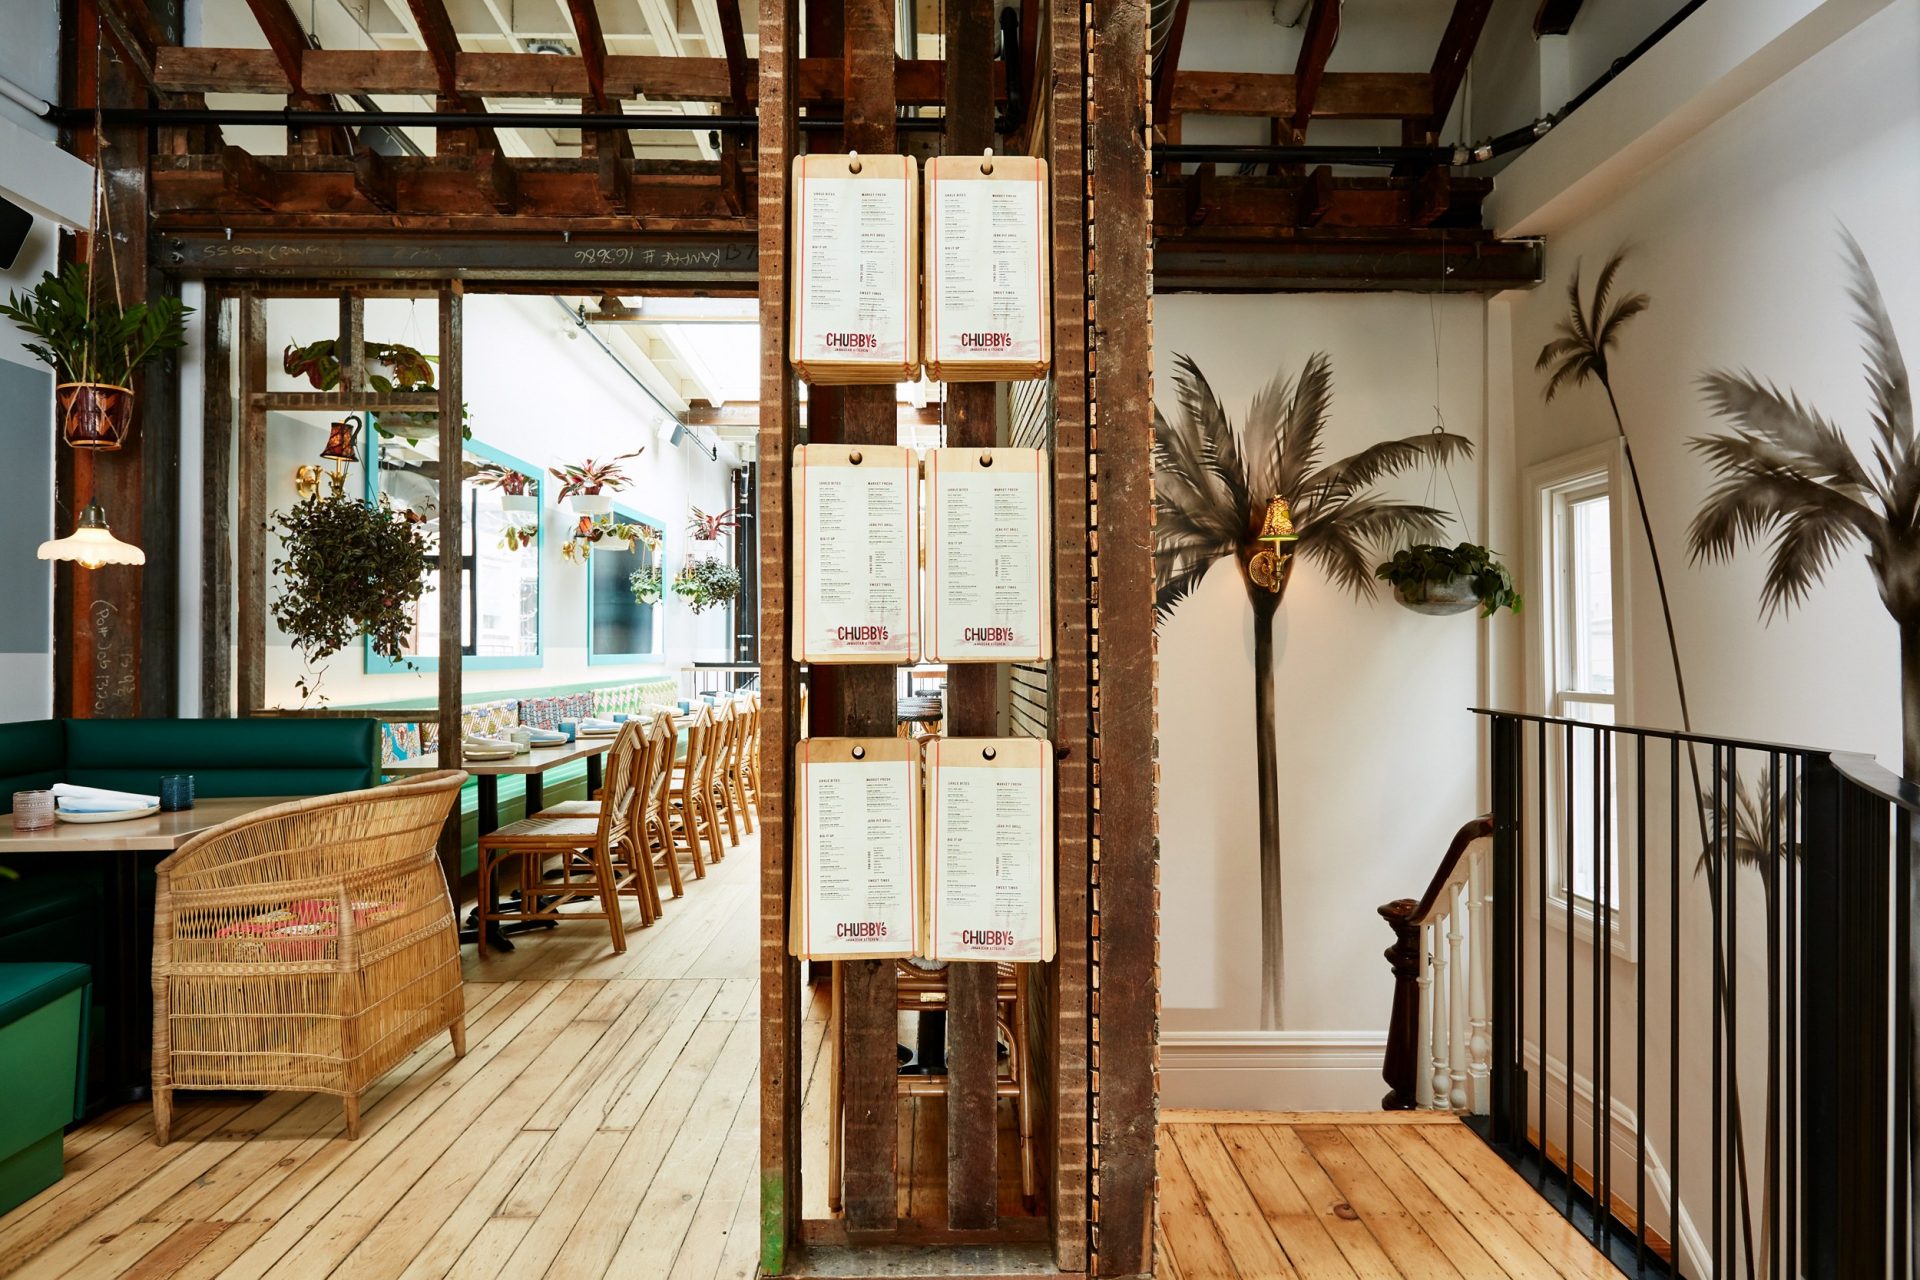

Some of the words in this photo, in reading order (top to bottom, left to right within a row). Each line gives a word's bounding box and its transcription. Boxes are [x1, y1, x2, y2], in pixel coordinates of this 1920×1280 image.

[826, 332, 877, 348] CHUBBY's
[961, 333, 1012, 347] CHUBBY's
[838, 626, 888, 640] CHUBBY's
[964, 627, 1013, 641] CHUBBY's
[837, 922, 887, 937] CHUBBY's
[962, 930, 1014, 946] CHUBBY's
